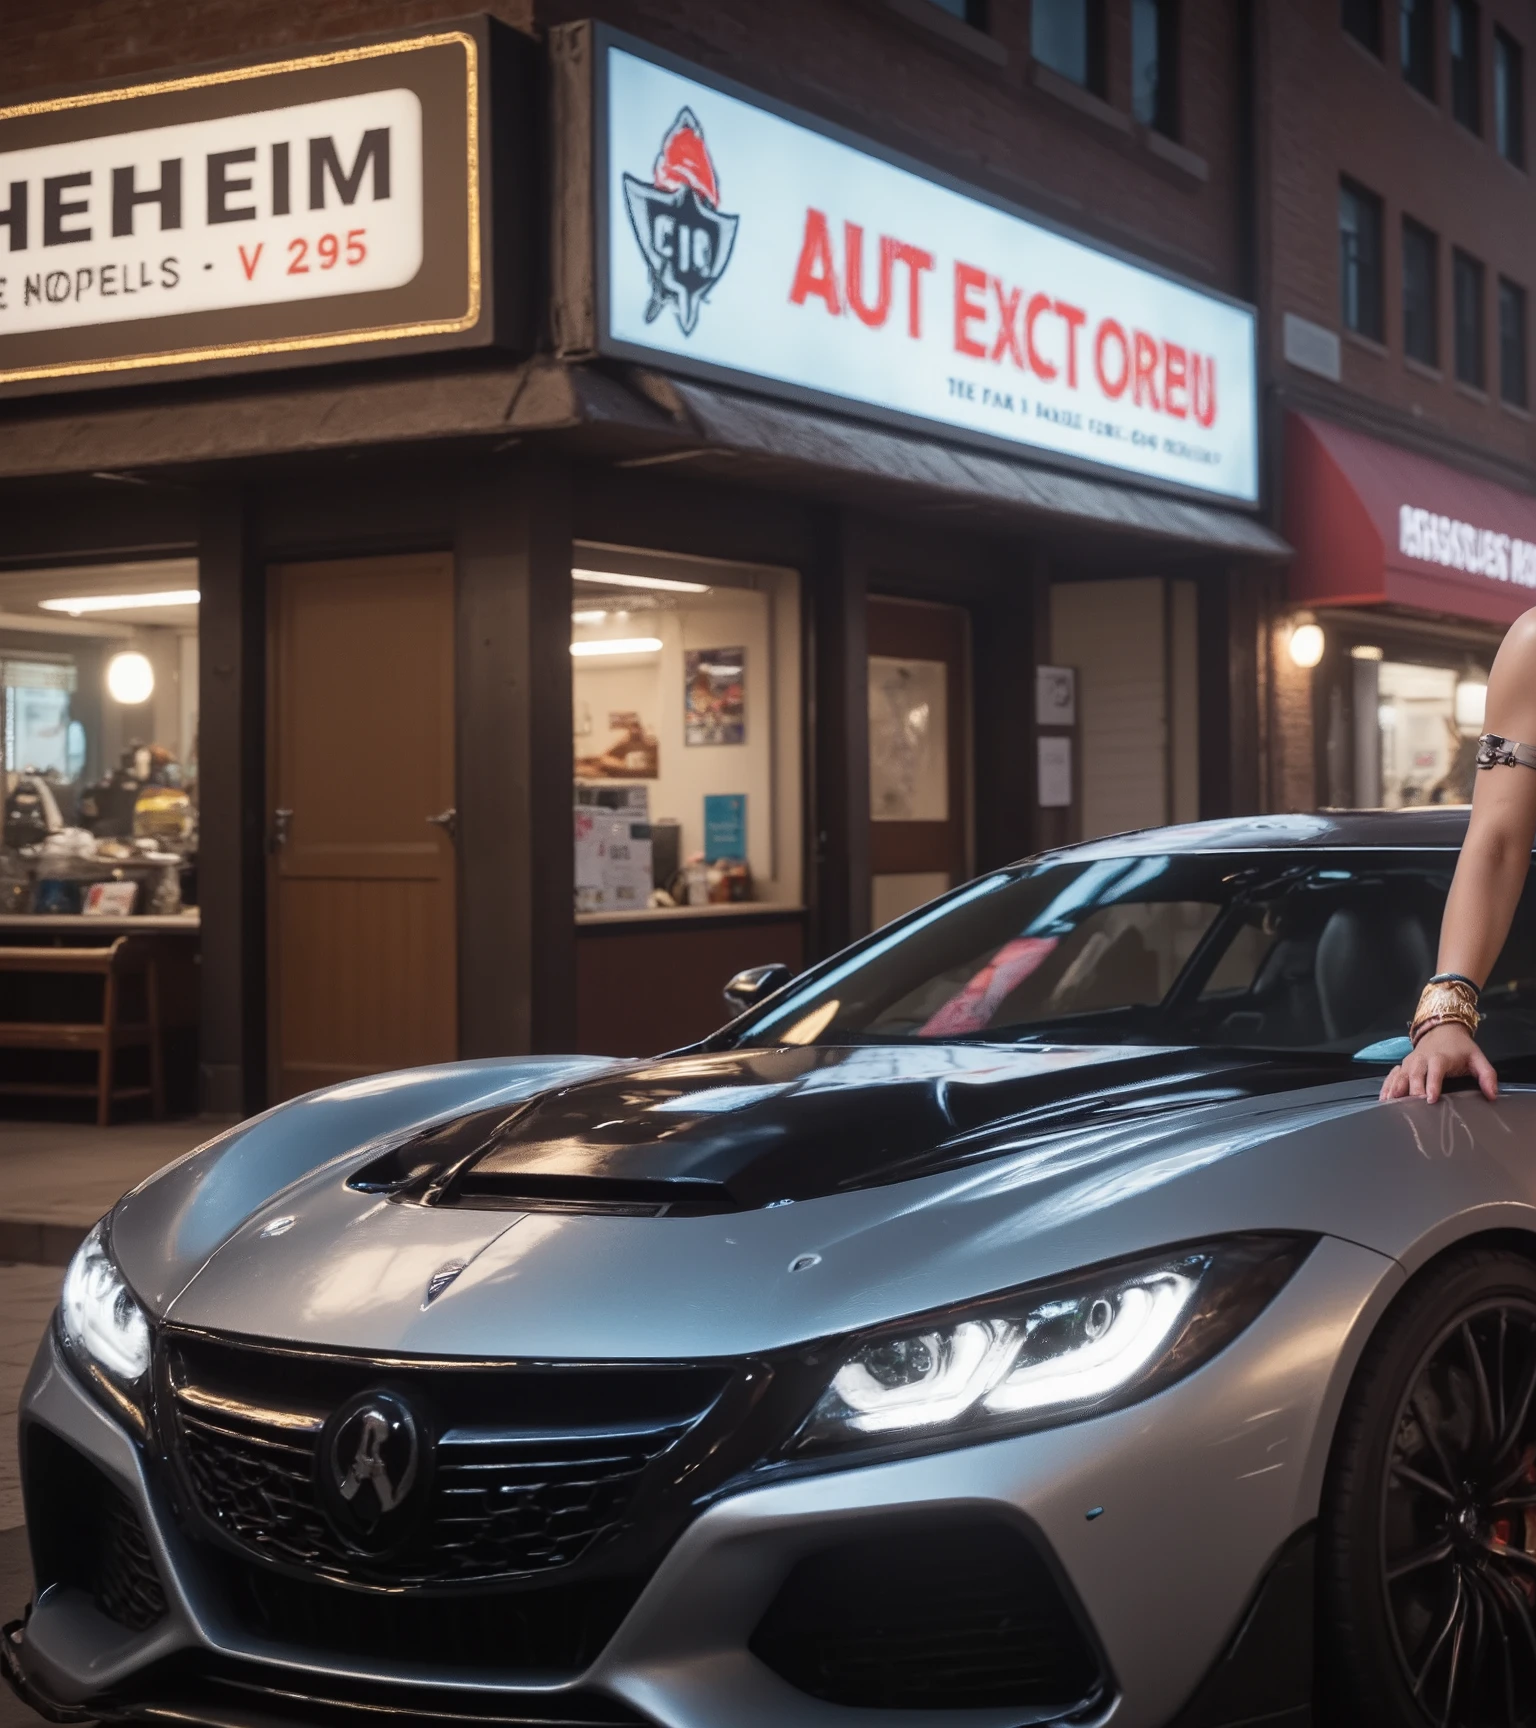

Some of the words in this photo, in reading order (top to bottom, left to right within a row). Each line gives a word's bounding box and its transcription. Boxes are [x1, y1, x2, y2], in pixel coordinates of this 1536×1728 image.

[239, 242, 264, 281] V
[287, 229, 367, 275] 295
[788, 206, 935, 340] AUT
